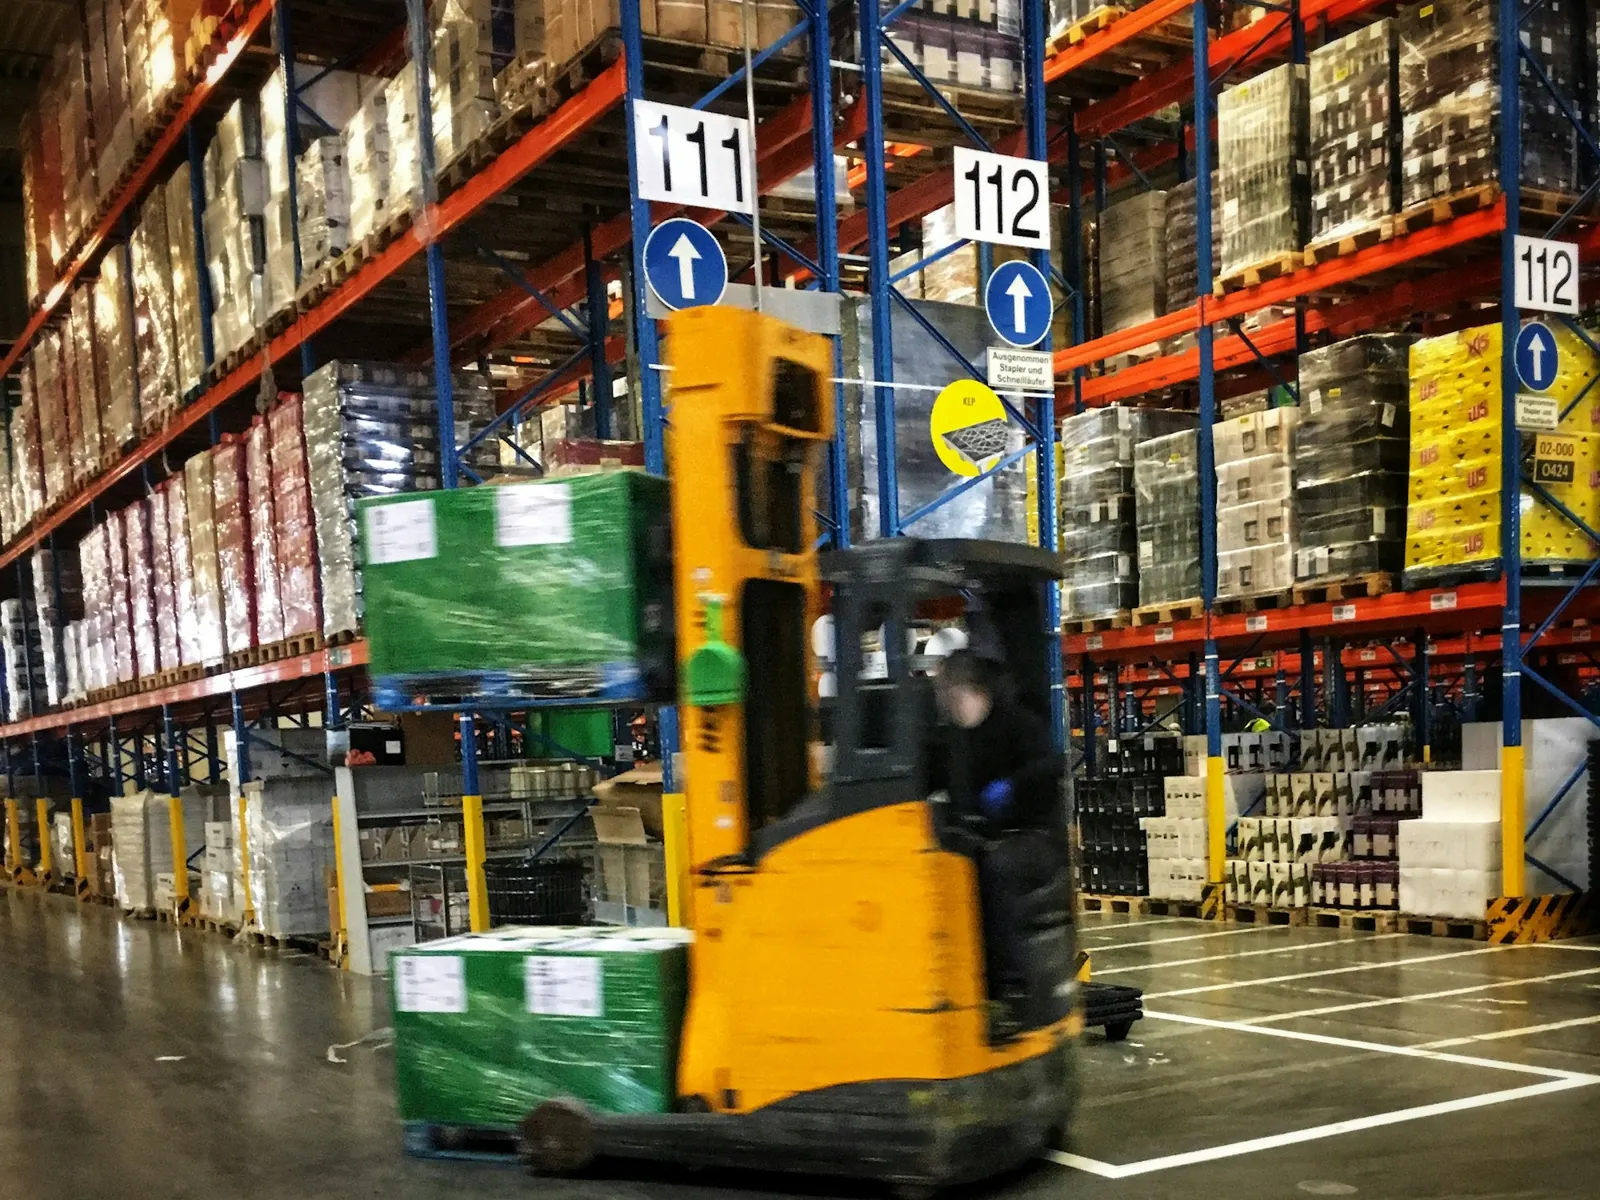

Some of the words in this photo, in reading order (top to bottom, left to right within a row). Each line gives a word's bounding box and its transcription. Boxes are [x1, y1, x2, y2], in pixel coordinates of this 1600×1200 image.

[648, 114, 744, 203] 111
[964, 160, 1041, 240] 112
[1521, 244, 1573, 307] 112
[992, 351, 1049, 364] Ausgenommen
[999, 363, 1026, 374] Stapler
[1028, 366, 1043, 375] und
[962, 396, 976, 407] KEP
[1539, 441, 1575, 457] 02-000
